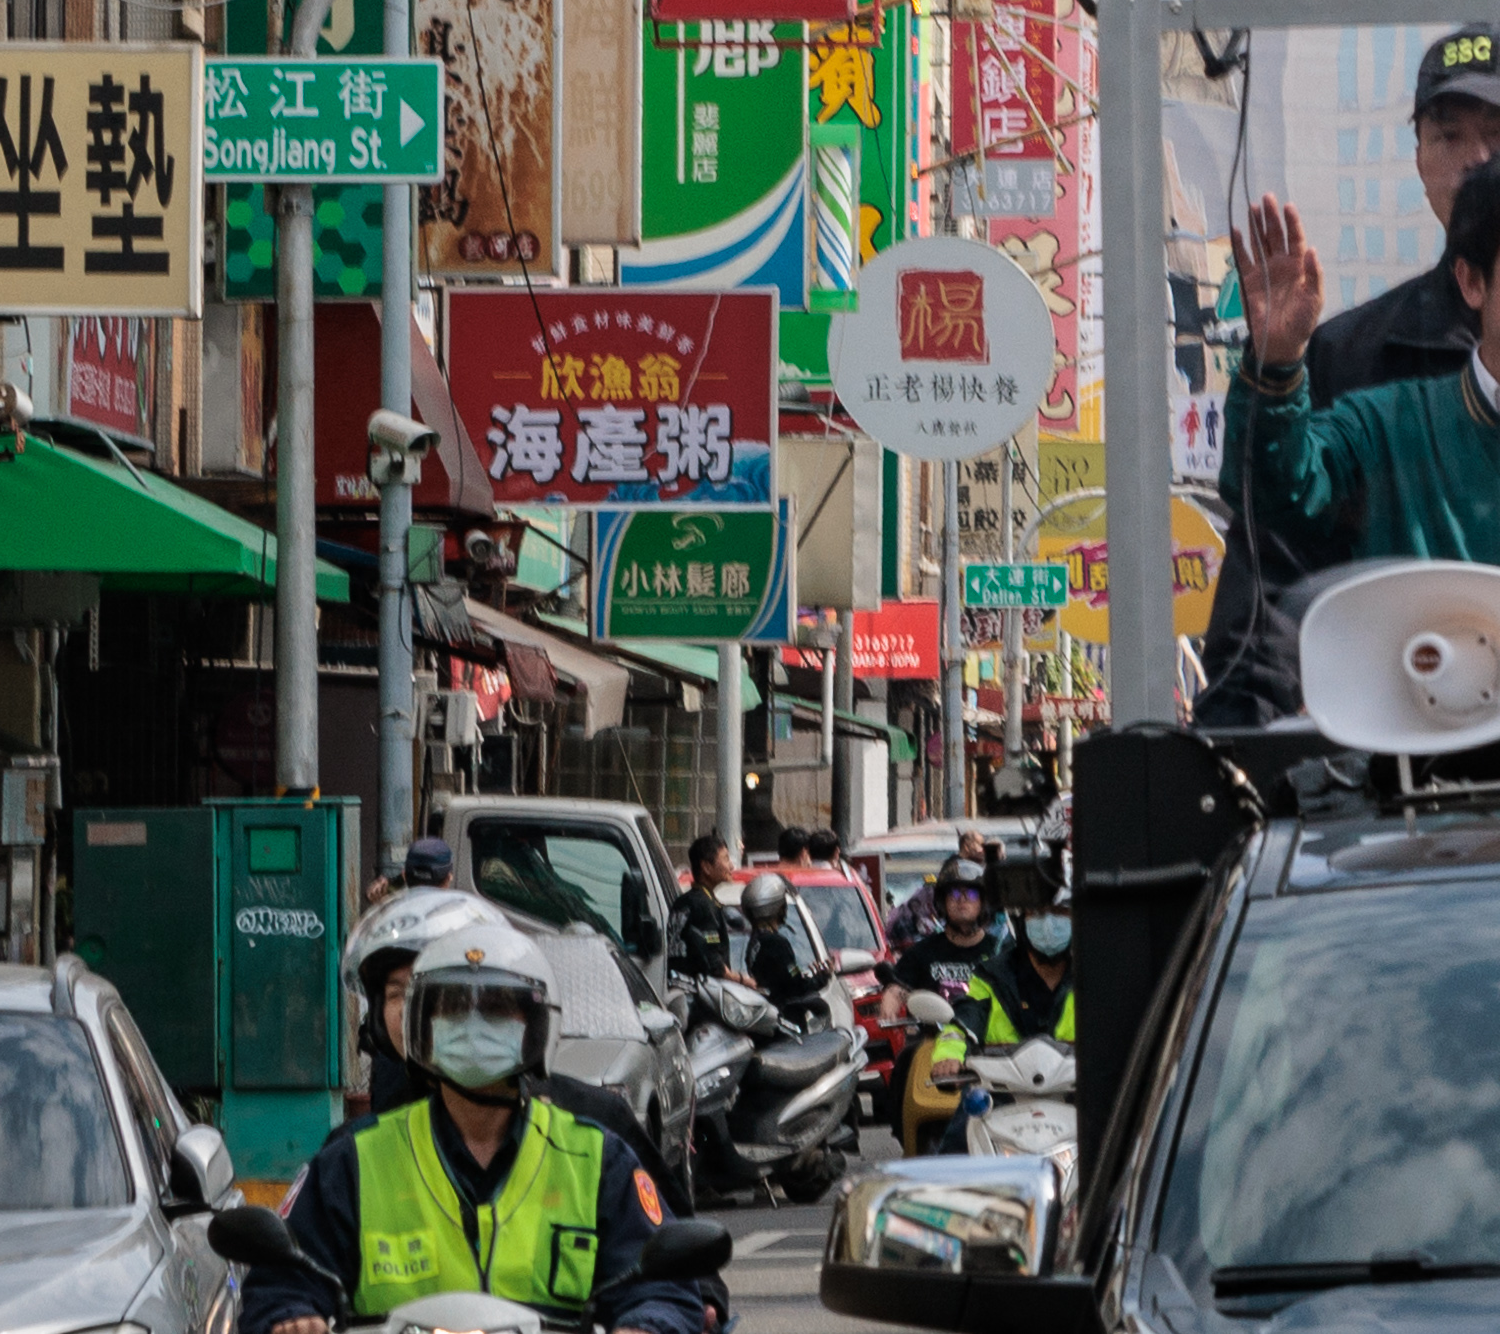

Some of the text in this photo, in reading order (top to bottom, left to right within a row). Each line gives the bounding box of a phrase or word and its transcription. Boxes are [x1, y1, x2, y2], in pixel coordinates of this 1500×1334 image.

[205, 67, 388, 121] 松江街
[205, 125, 388, 175] Songjiang St.
[487, 402, 732, 485] 海產粥
[373, 1258, 430, 1276] POLICE
